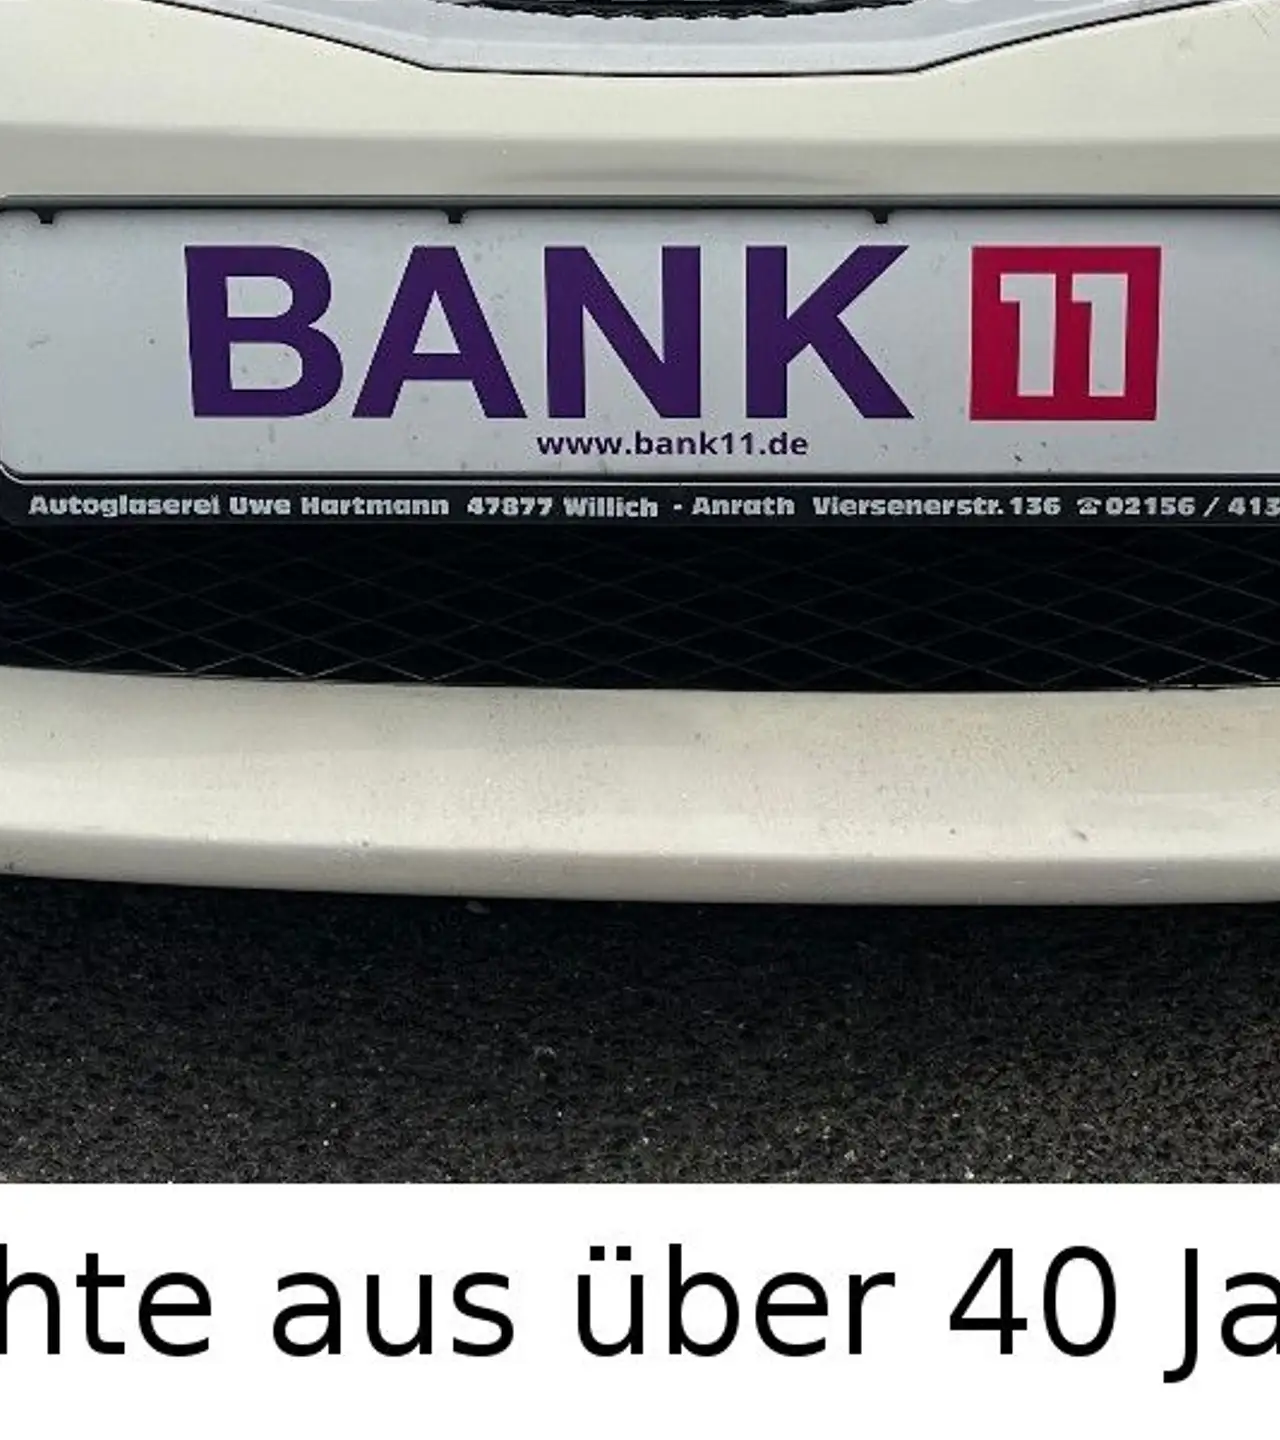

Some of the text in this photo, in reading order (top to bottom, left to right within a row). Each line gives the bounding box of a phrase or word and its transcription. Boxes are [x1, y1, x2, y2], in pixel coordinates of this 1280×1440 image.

[184, 244, 1129, 420] BANK 11
[536, 429, 810, 456] www.bank11.de
[28, 494, 221, 518] Autoglaserei
[229, 496, 291, 516] Uwe
[301, 496, 450, 516] Hartmann
[467, 496, 553, 517] 47877
[563, 496, 659, 518] Willich
[691, 496, 795, 516] Anrath
[812, 496, 1005, 517] Viersenerstr.
[1009, 496, 1061, 516] 136
[1105, 496, 1196, 516] 02156
